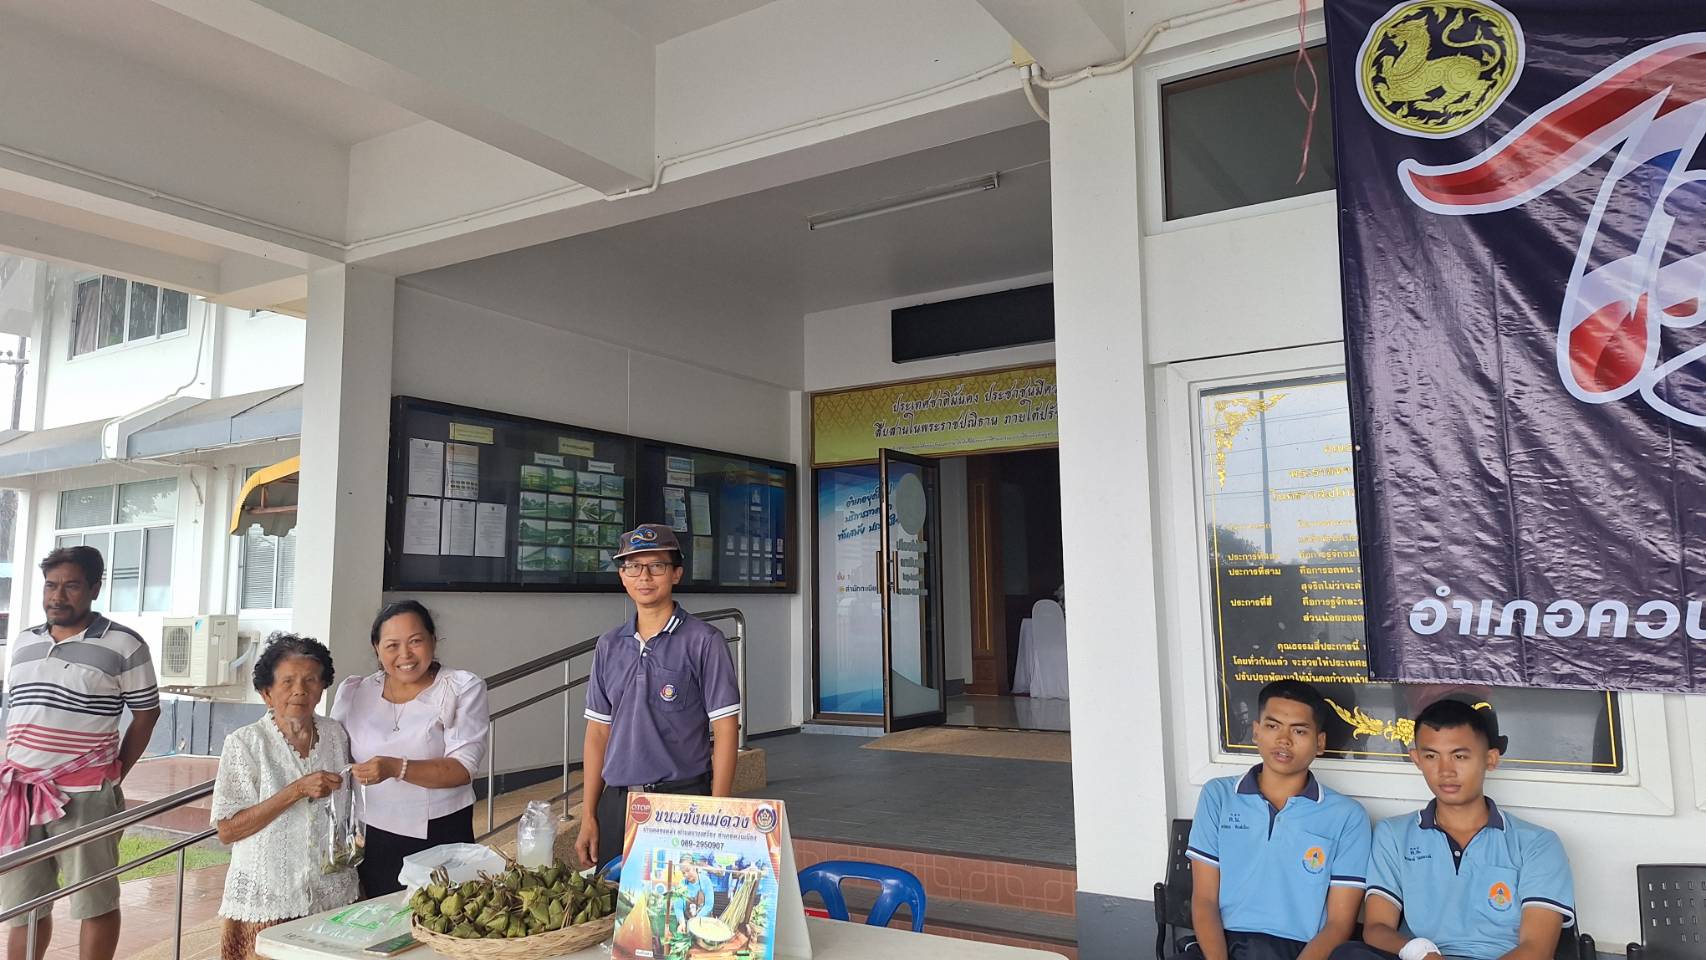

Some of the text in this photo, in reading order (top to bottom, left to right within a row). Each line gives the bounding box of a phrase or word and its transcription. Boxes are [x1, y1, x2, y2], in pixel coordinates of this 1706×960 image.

[1228, 563, 1281, 576] ประการที่สาม
[1230, 595, 1272, 607] ประการที่สี่
[631, 804, 651, 812] OTOP
